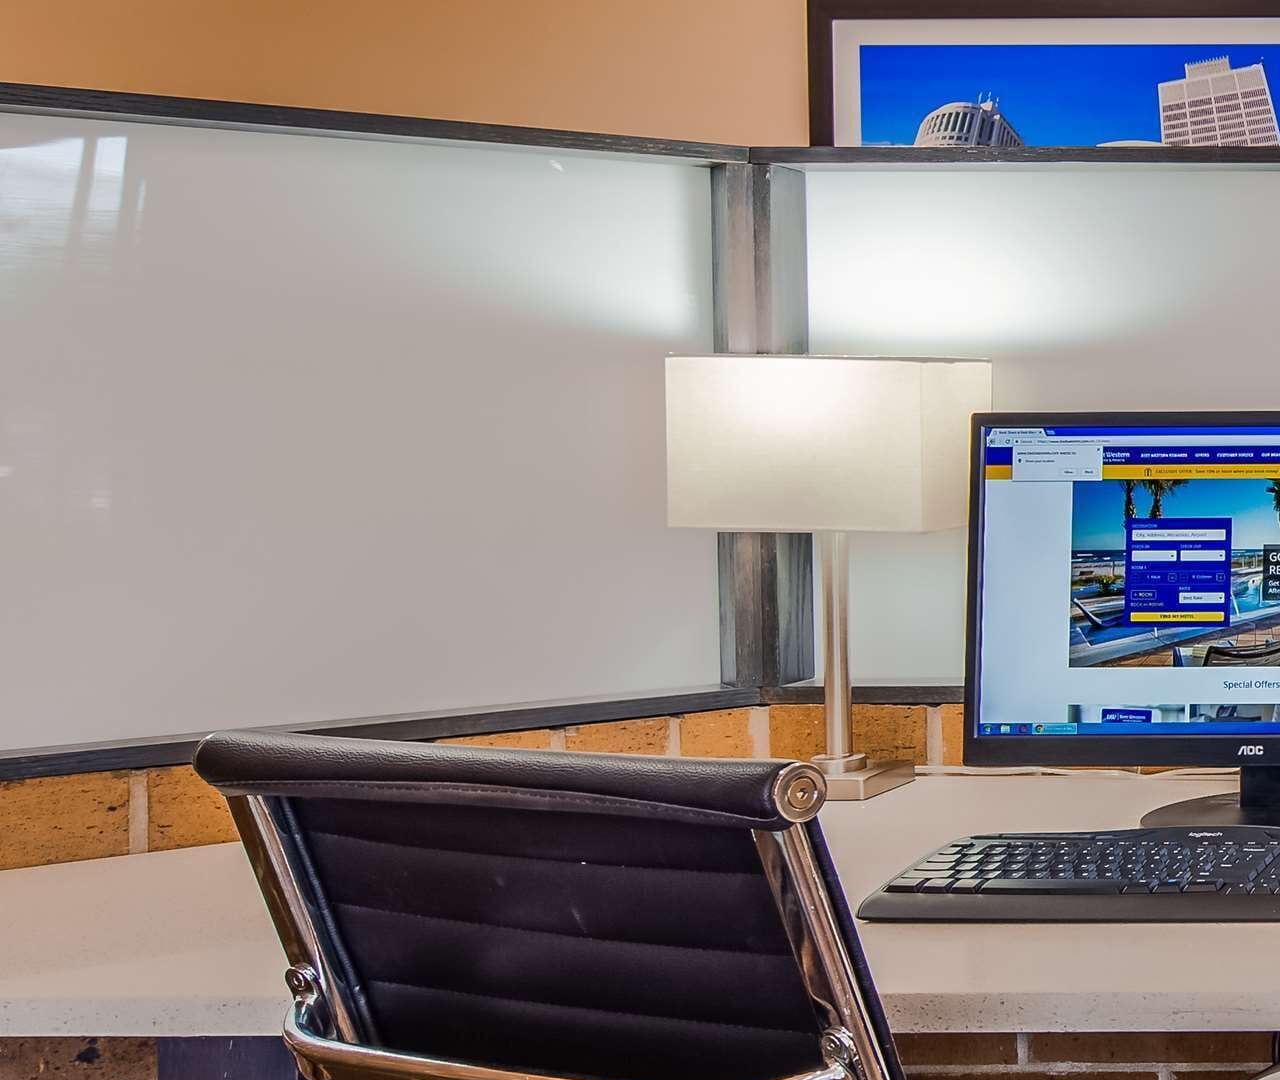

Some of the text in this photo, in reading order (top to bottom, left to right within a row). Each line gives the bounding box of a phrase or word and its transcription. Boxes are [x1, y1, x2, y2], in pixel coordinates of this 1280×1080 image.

[1223, 680, 1280, 691] Special Offers
[1237, 745, 1264, 756] AOC
